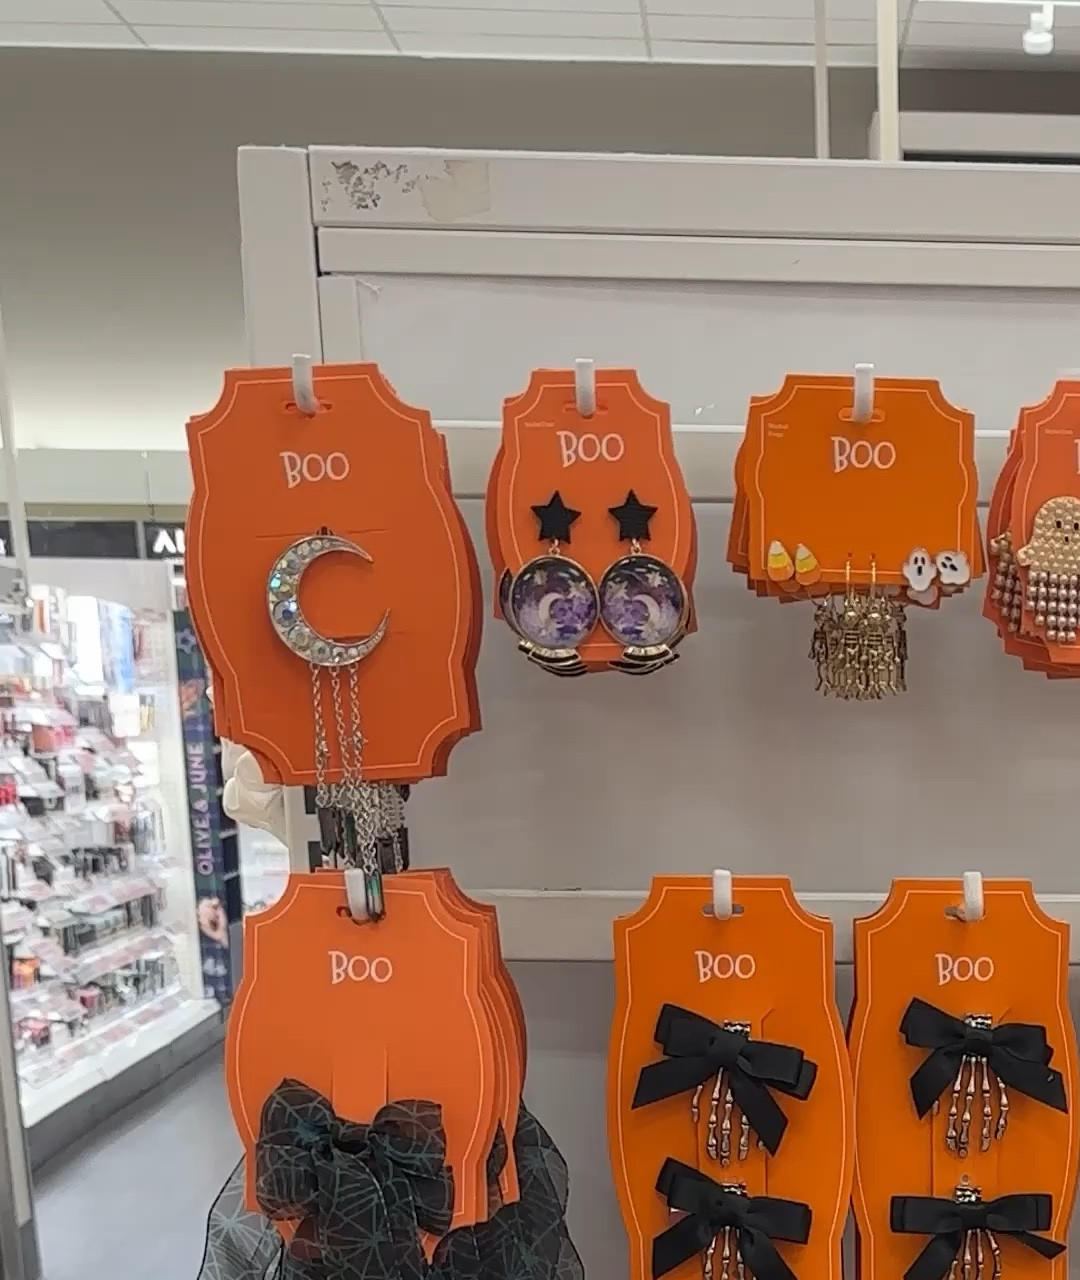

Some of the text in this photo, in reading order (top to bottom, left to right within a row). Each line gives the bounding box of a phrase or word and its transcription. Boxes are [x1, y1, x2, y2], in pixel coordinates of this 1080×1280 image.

[556, 430, 625, 468] BOO
[831, 436, 896, 473] BOO
[279, 451, 350, 489] BOO
[187, 741, 209, 796] JUNE
[193, 814, 214, 877] OLIVE
[328, 950, 393, 985] BOO
[694, 950, 757, 983] BOO
[935, 953, 996, 986] BOO
